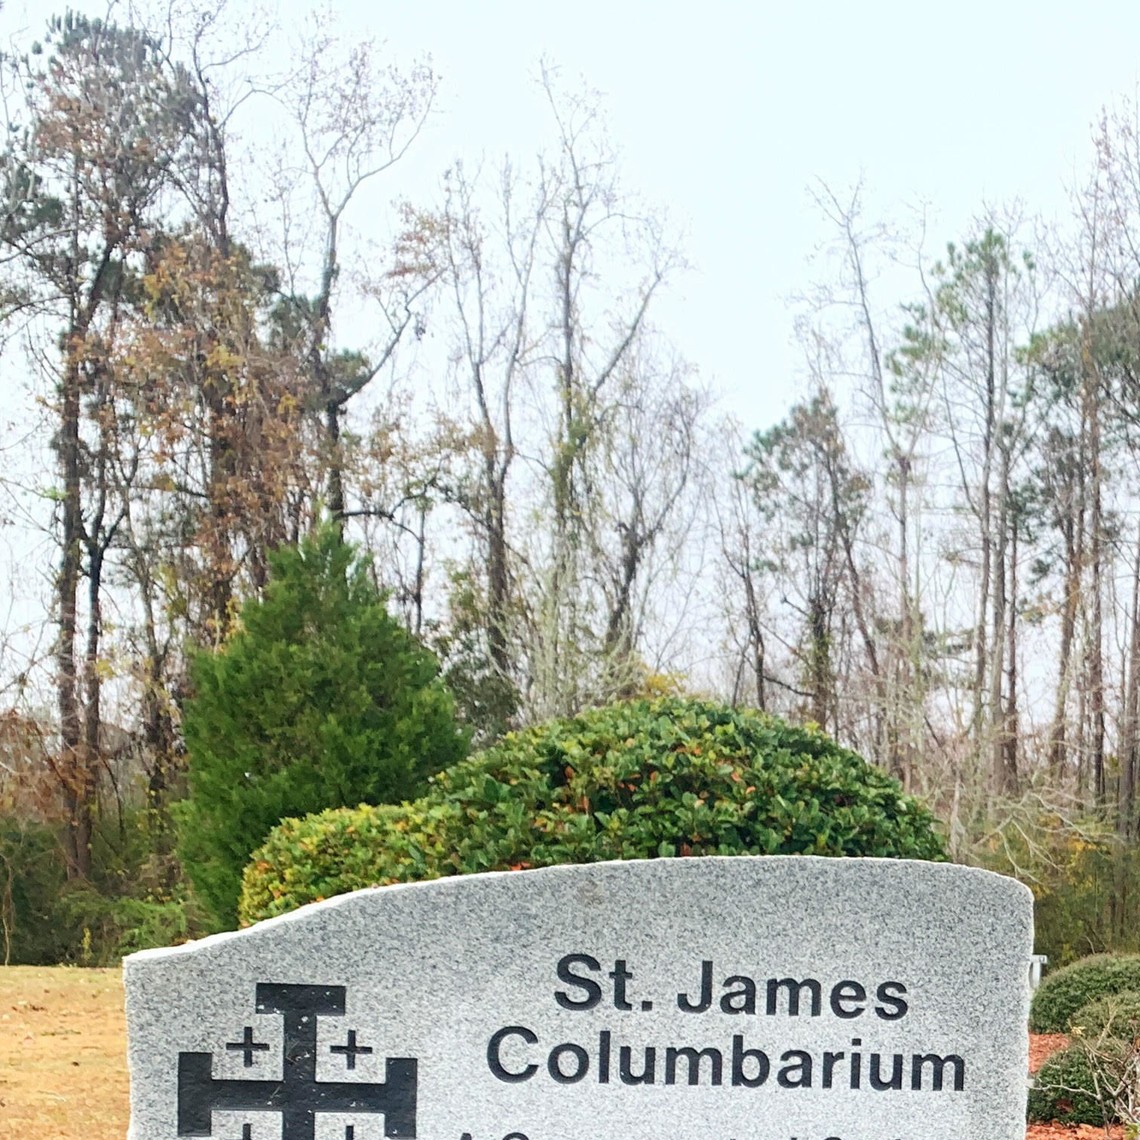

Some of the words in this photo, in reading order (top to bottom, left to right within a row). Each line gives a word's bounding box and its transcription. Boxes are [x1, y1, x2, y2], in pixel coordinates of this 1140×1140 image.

[554, 952, 653, 1012] St.
[676, 959, 910, 1022] James
[486, 1025, 966, 1092] Columbarium
